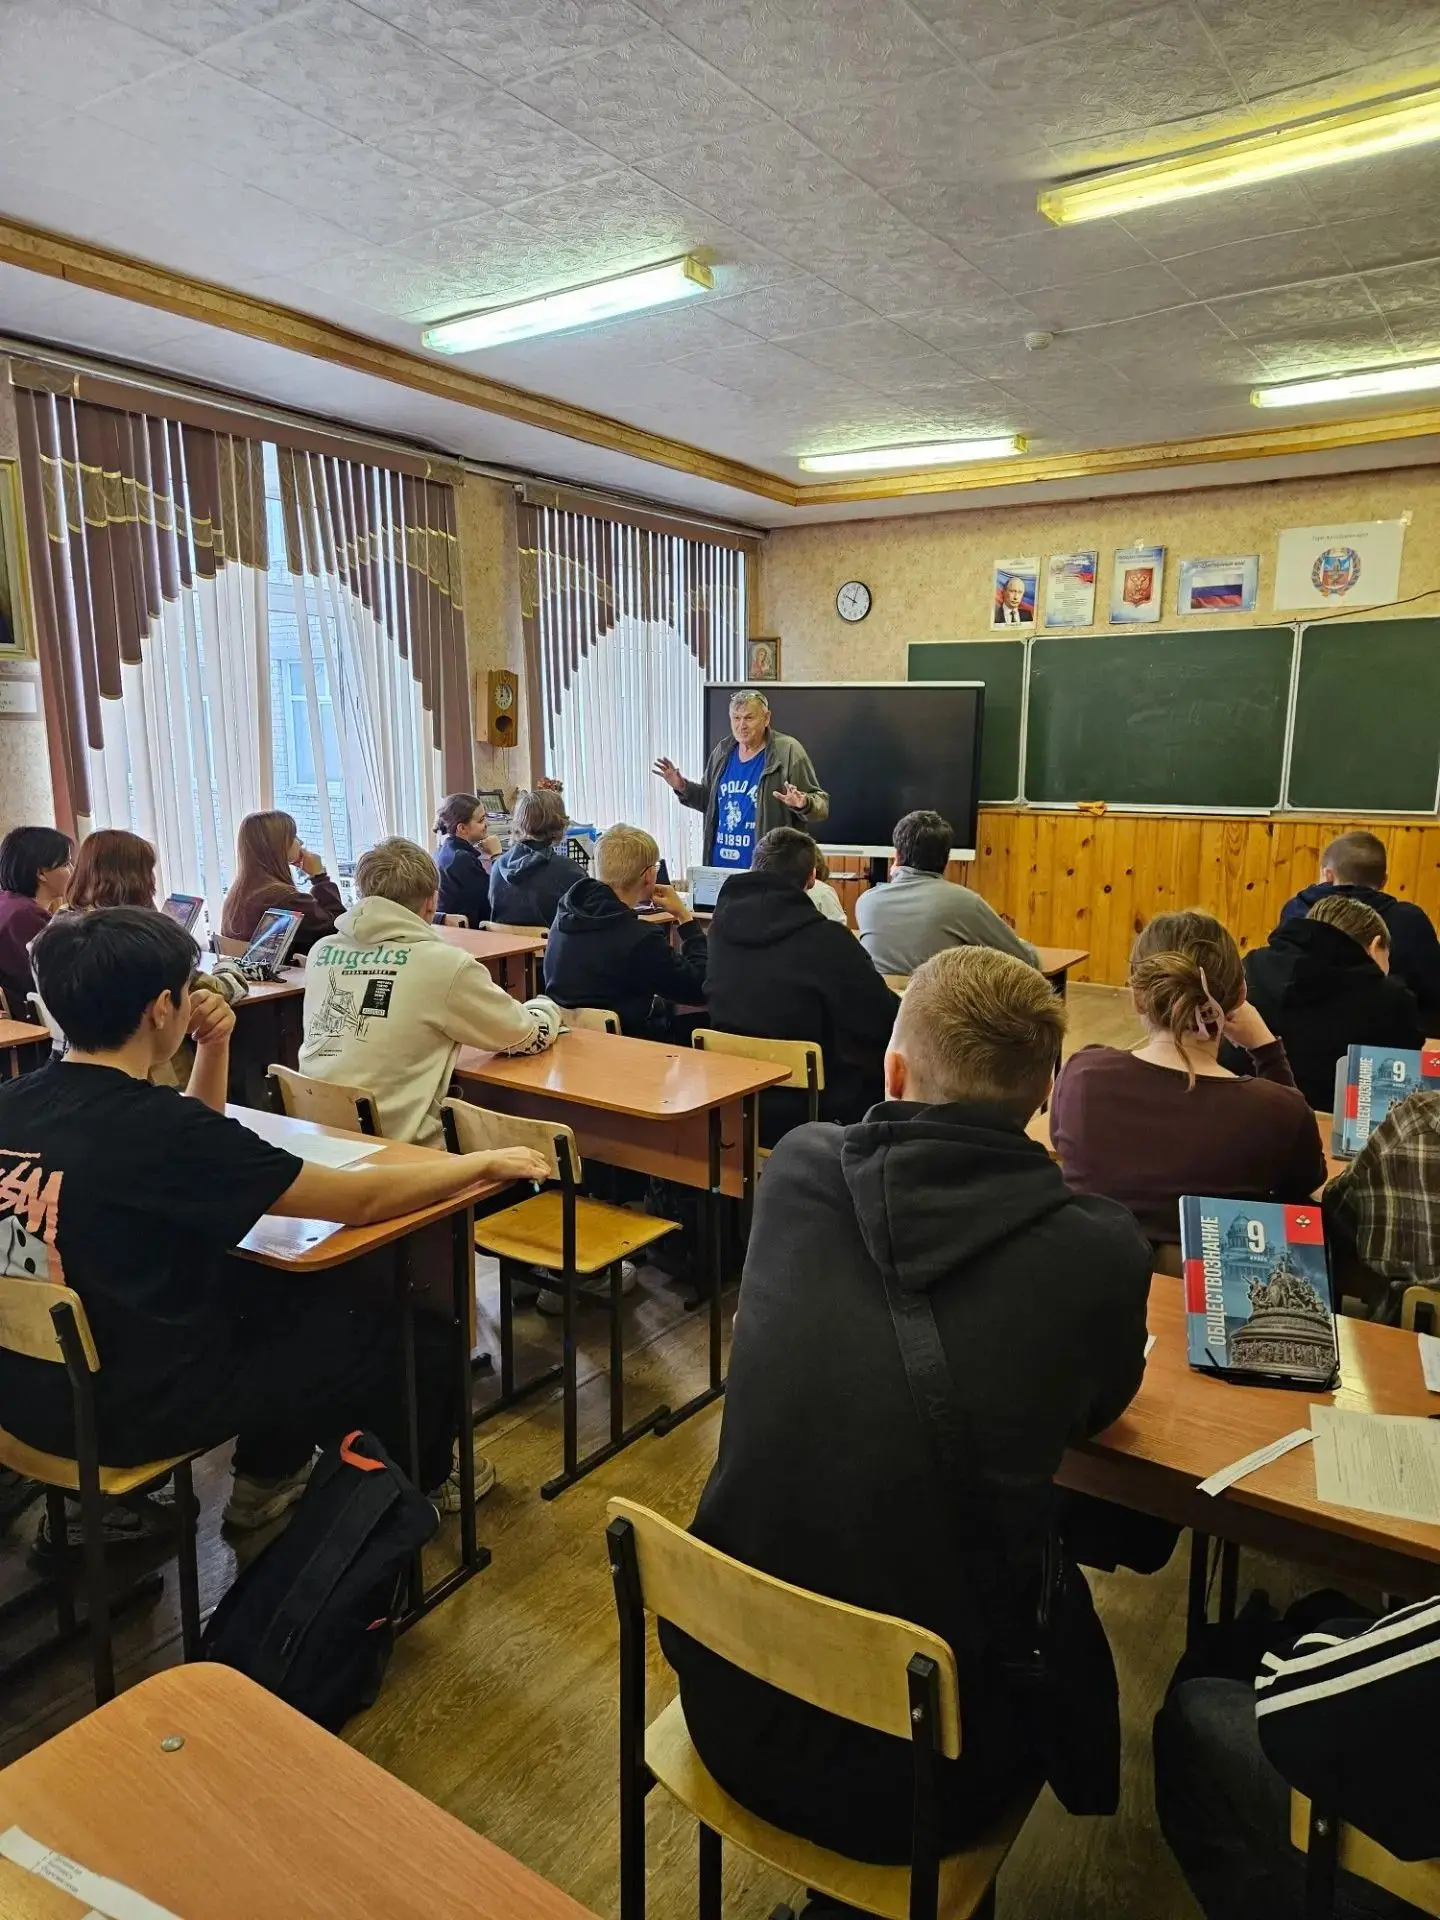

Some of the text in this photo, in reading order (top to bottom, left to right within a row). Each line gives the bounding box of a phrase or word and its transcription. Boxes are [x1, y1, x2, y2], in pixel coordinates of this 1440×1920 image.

[720, 780, 749, 797] POLO
[724, 834, 751, 847] 1890
[313, 945, 411, 969] Angeles
[1393, 1061, 1406, 1083] 9
[1247, 1220, 1265, 1253] 9
[1200, 1216, 1227, 1346] ОБЩЕСТВОЗНАНИЕ
